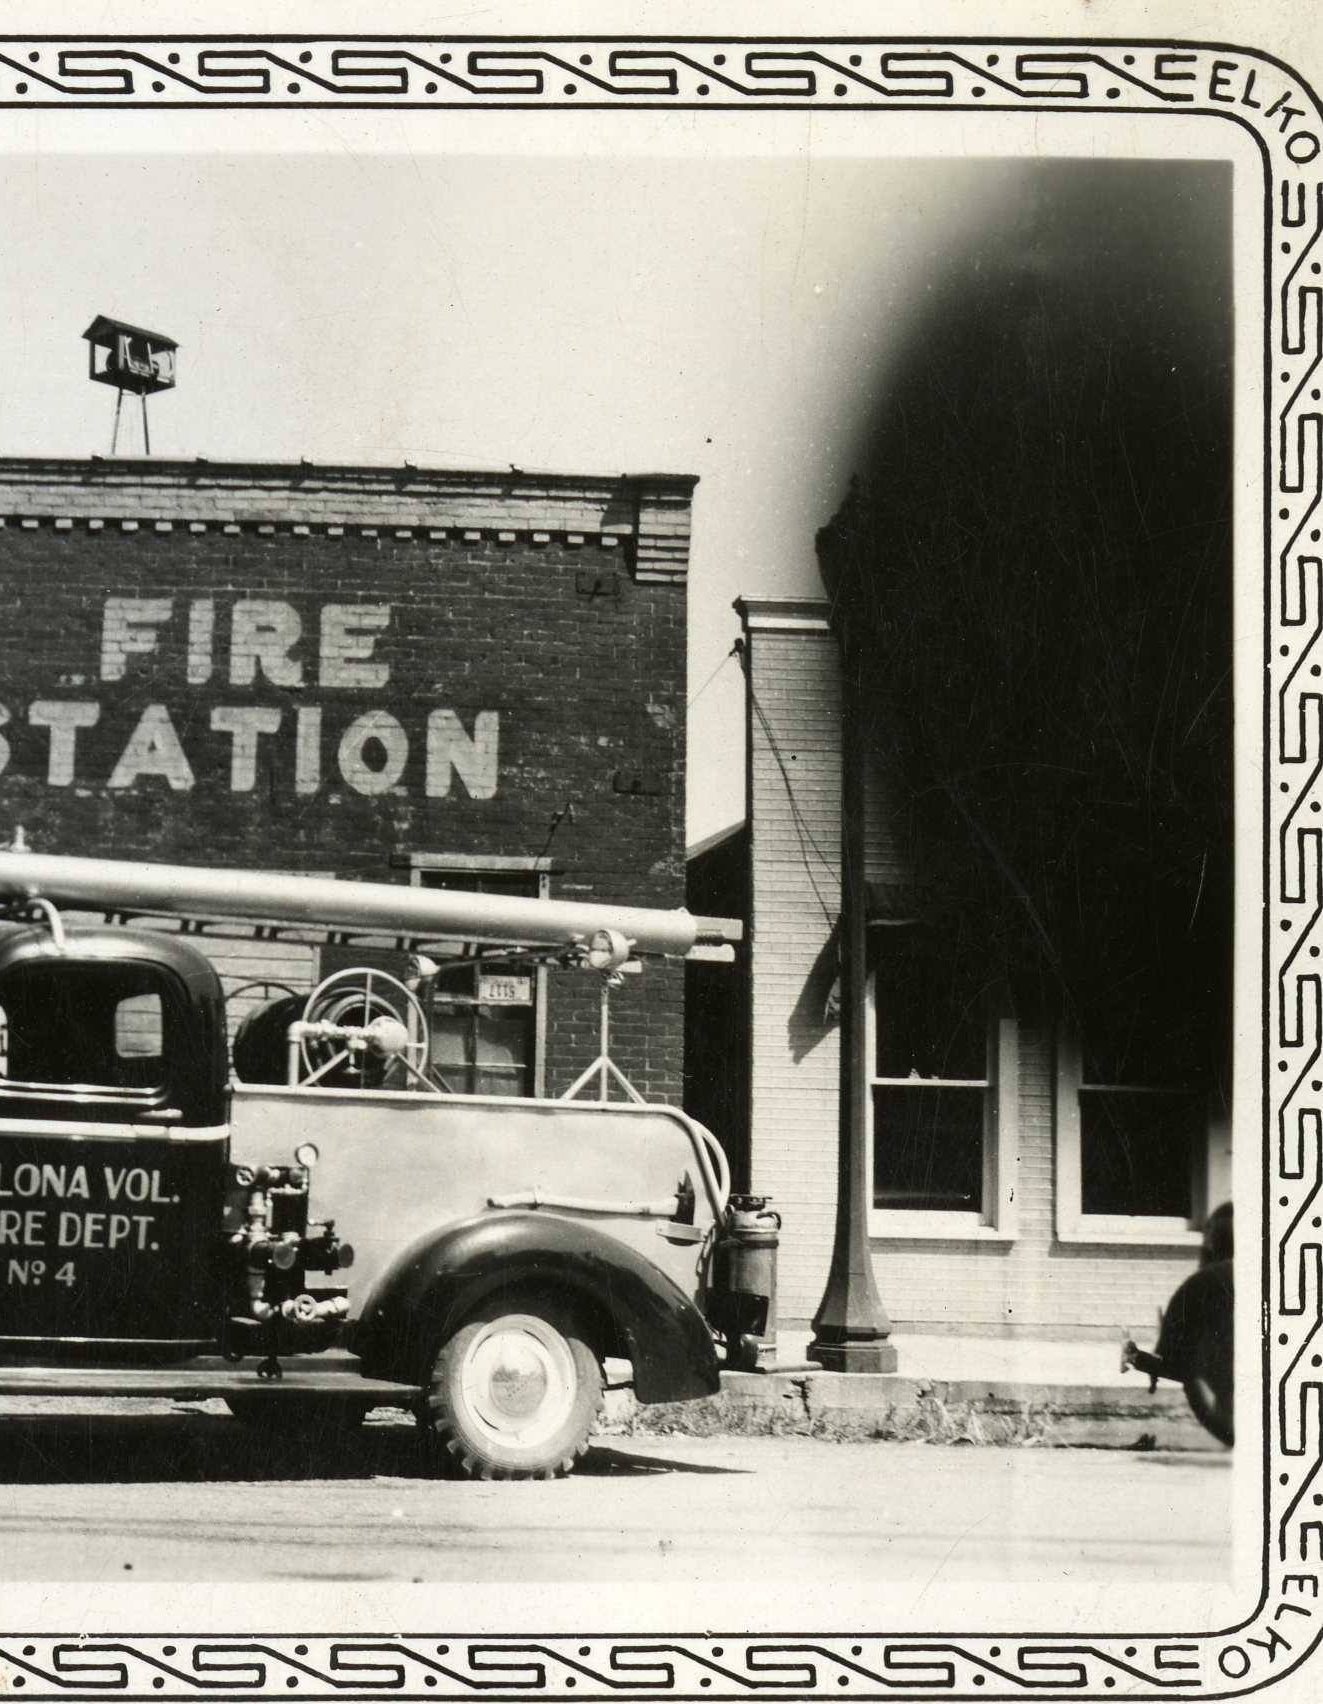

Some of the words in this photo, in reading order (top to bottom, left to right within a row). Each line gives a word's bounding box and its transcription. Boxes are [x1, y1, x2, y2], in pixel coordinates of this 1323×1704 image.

[1208, 60, 1321, 164] ELKO
[100, 598, 392, 688] FIRE
[103, 1166, 181, 1203] VOL.
[57, 1211, 160, 1251] DEPT.
[54, 1261, 77, 1287] 4
[1218, 1574, 1319, 1679] ELKO
